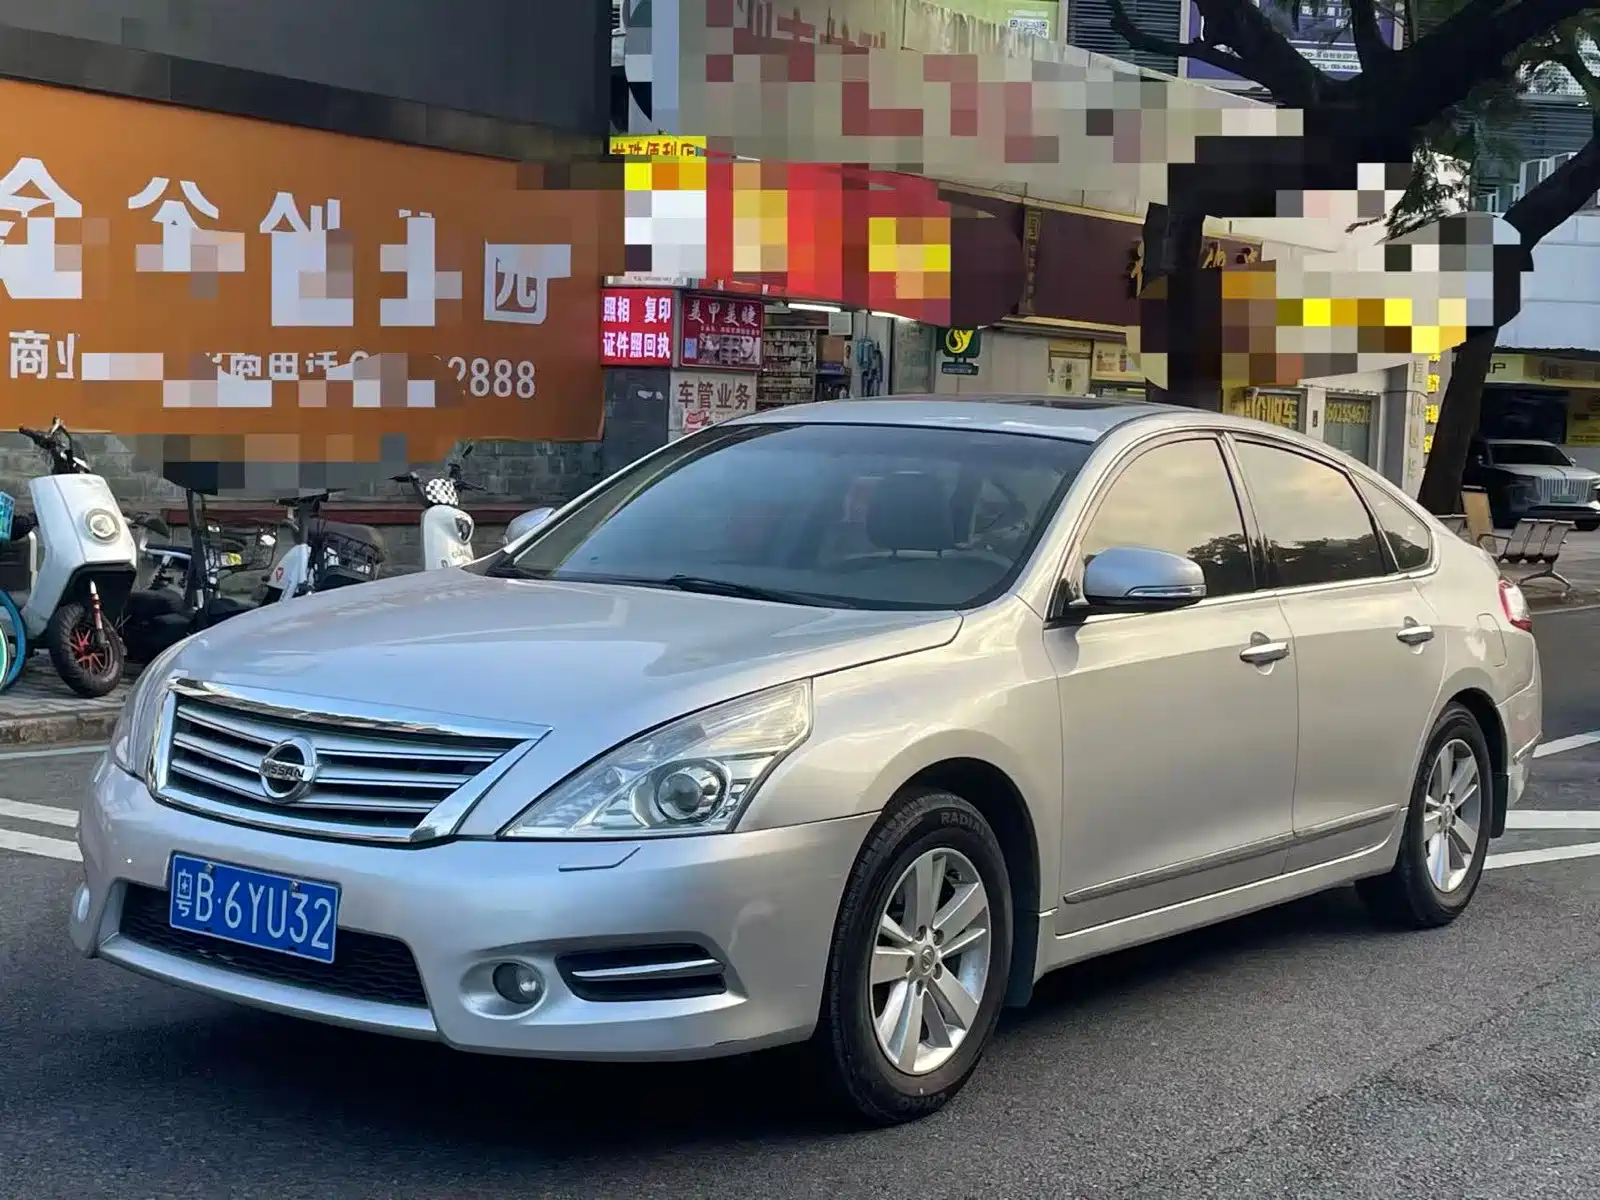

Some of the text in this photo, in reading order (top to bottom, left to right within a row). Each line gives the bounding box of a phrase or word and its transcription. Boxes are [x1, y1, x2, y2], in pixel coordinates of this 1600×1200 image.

[603, 296, 672, 323] 照相 复印
[602, 331, 671, 359] 证件照回执
[678, 380, 750, 410] 车管业务
